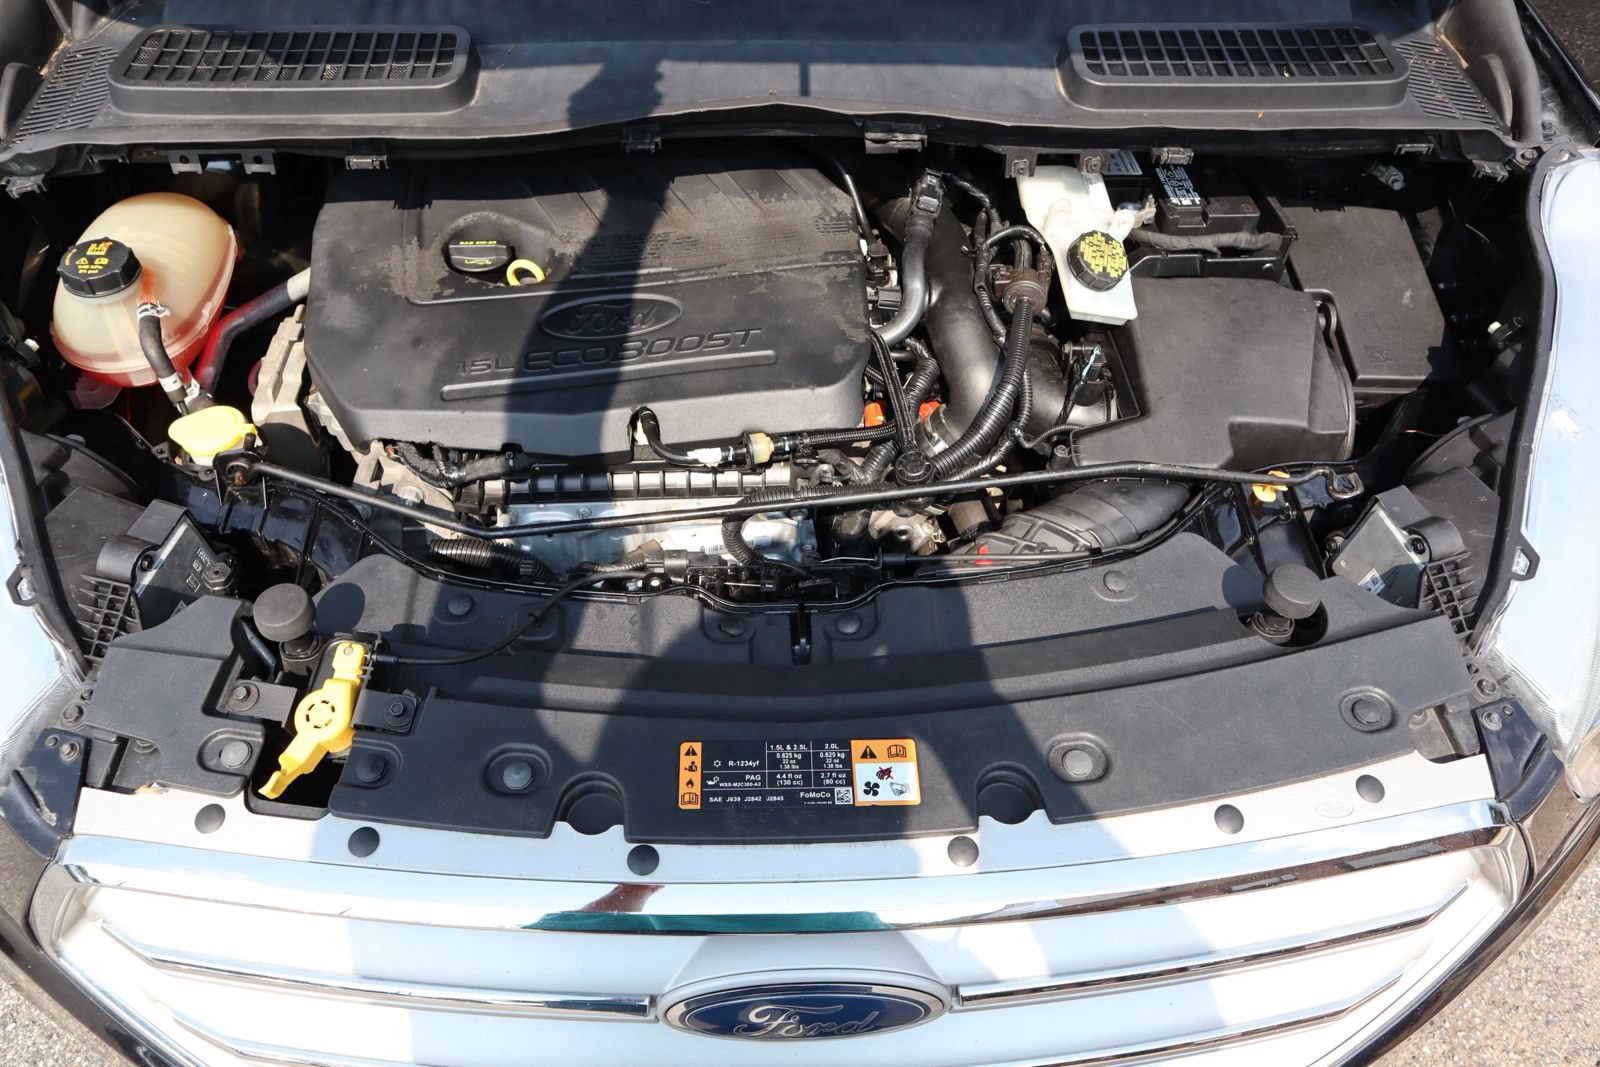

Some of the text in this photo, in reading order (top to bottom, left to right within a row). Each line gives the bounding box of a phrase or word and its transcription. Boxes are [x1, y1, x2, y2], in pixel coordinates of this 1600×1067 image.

[565, 303, 658, 335] Ford
[523, 327, 762, 373] ECOBOOST
[733, 1004, 880, 1037] Ford
